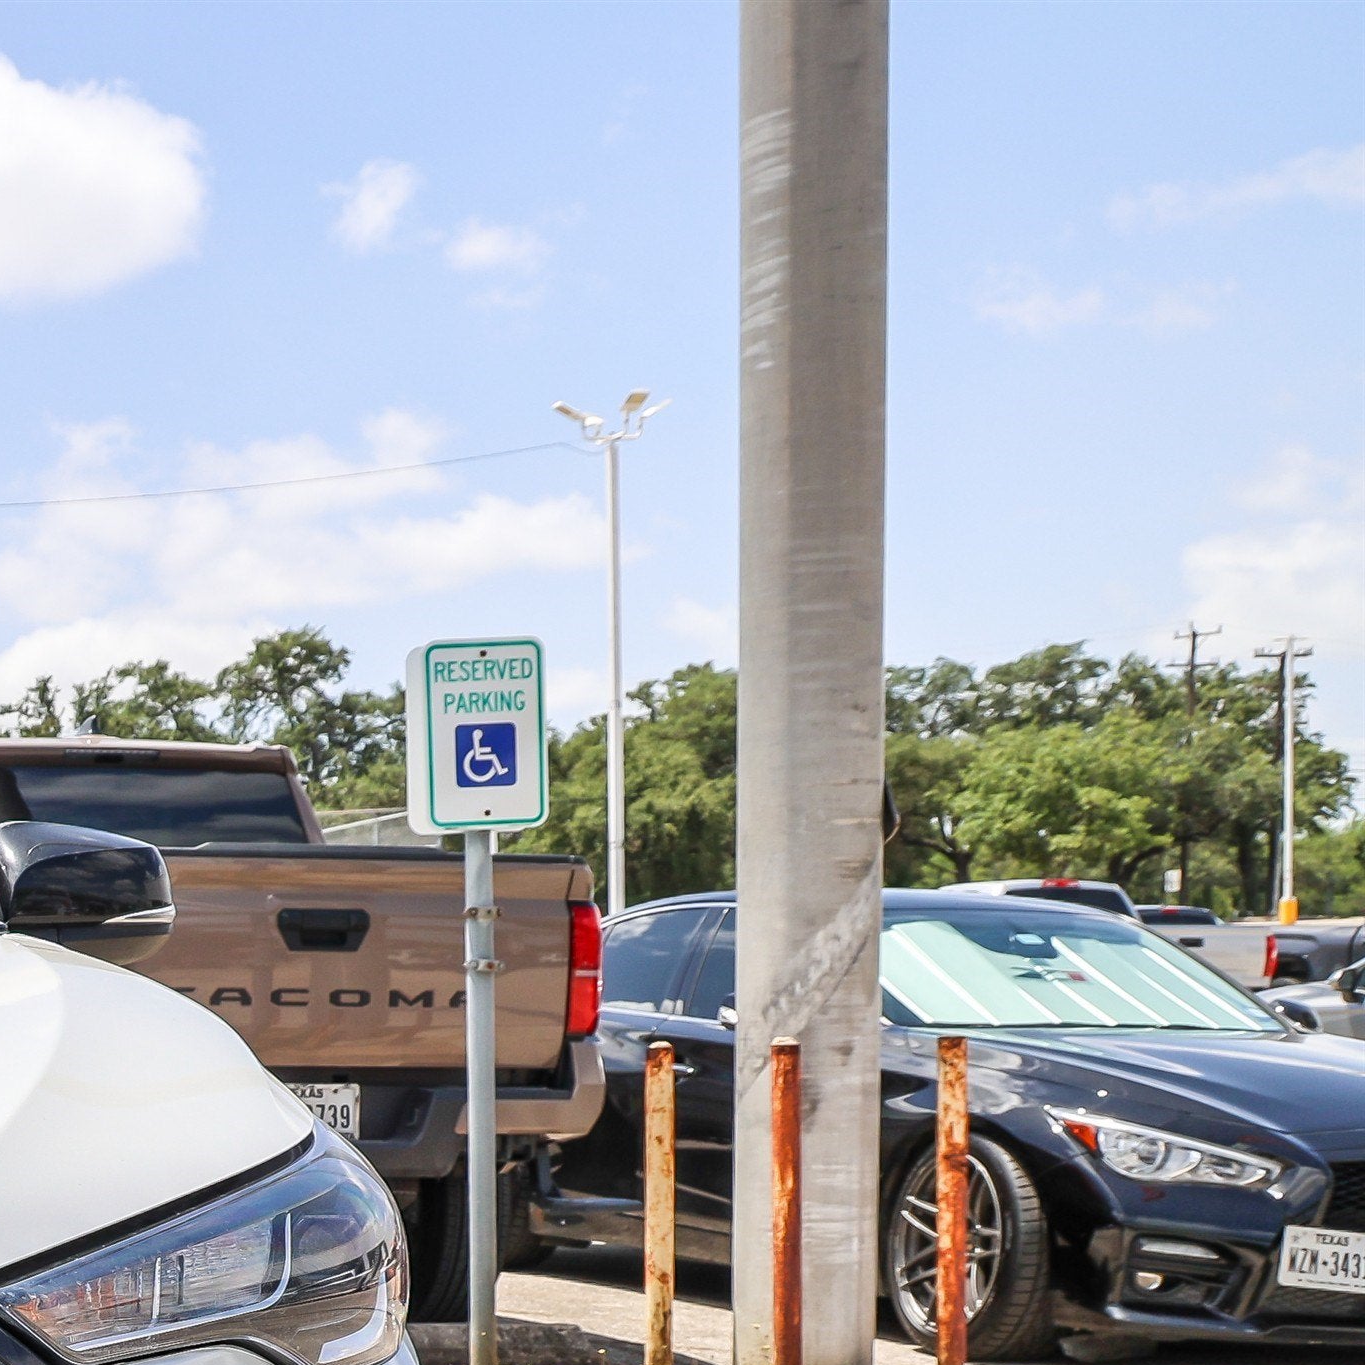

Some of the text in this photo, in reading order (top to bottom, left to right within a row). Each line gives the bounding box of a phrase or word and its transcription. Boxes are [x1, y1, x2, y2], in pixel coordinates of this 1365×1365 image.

[434, 658, 534, 683] RESERVED
[444, 690, 526, 714] PARKING
[1316, 1233, 1350, 1247] TEXAS
